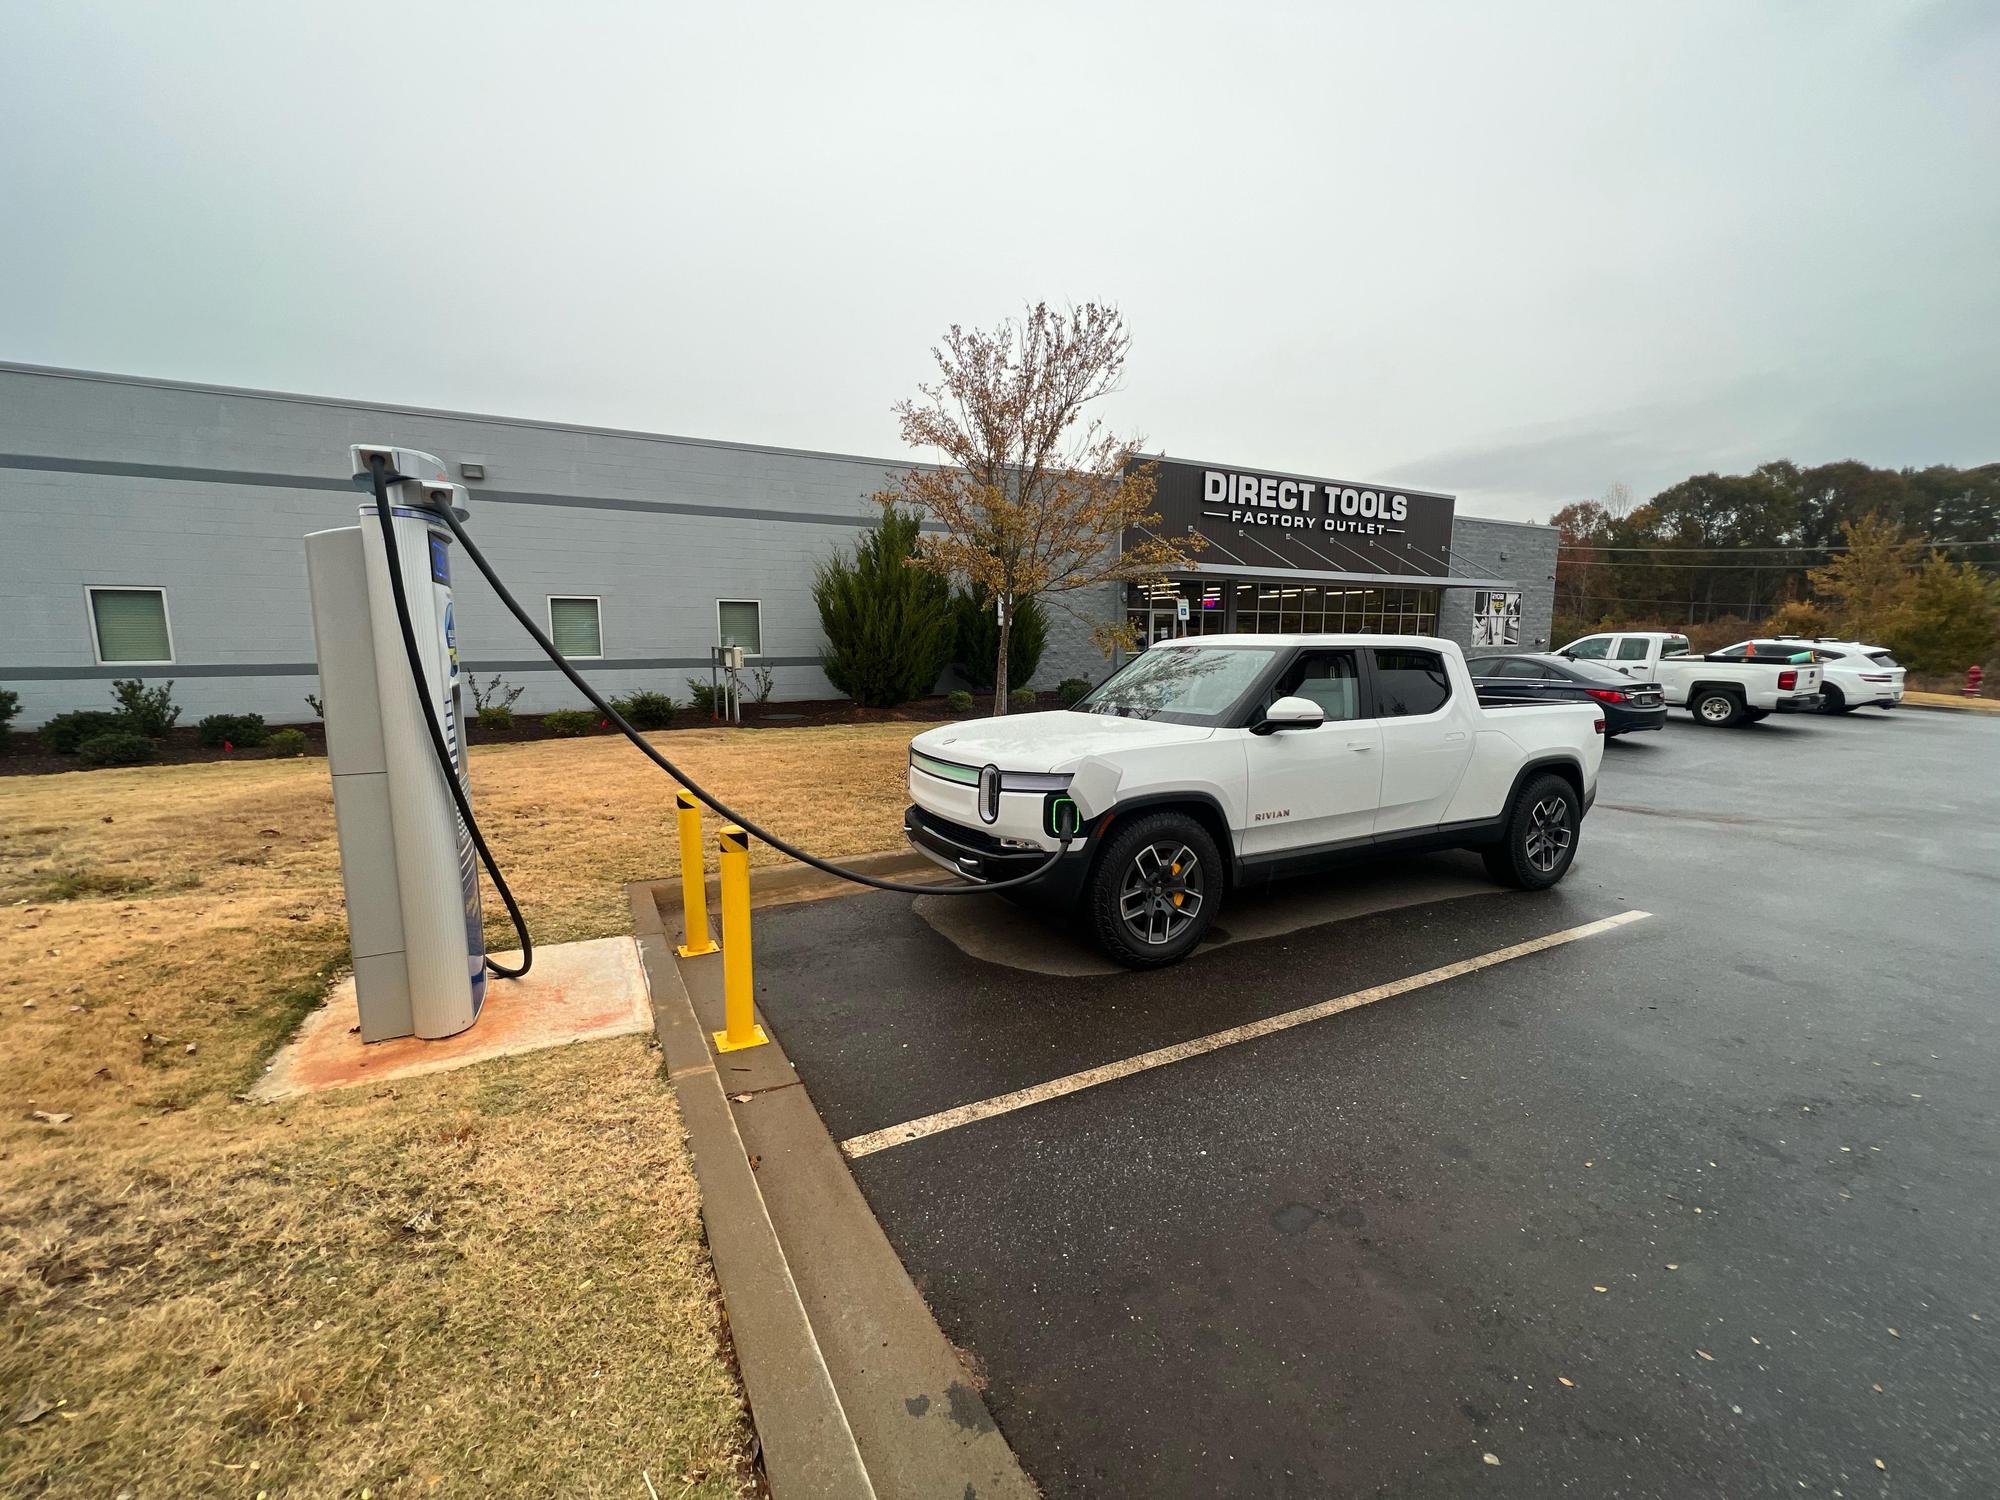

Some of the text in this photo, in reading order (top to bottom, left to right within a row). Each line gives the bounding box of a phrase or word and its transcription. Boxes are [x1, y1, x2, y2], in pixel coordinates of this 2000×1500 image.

[1204, 471, 1408, 521] DIRECT TOOLS
[1232, 510, 1385, 535] FACTORY OUTLET
[1255, 809, 1291, 821] RIVIAN
